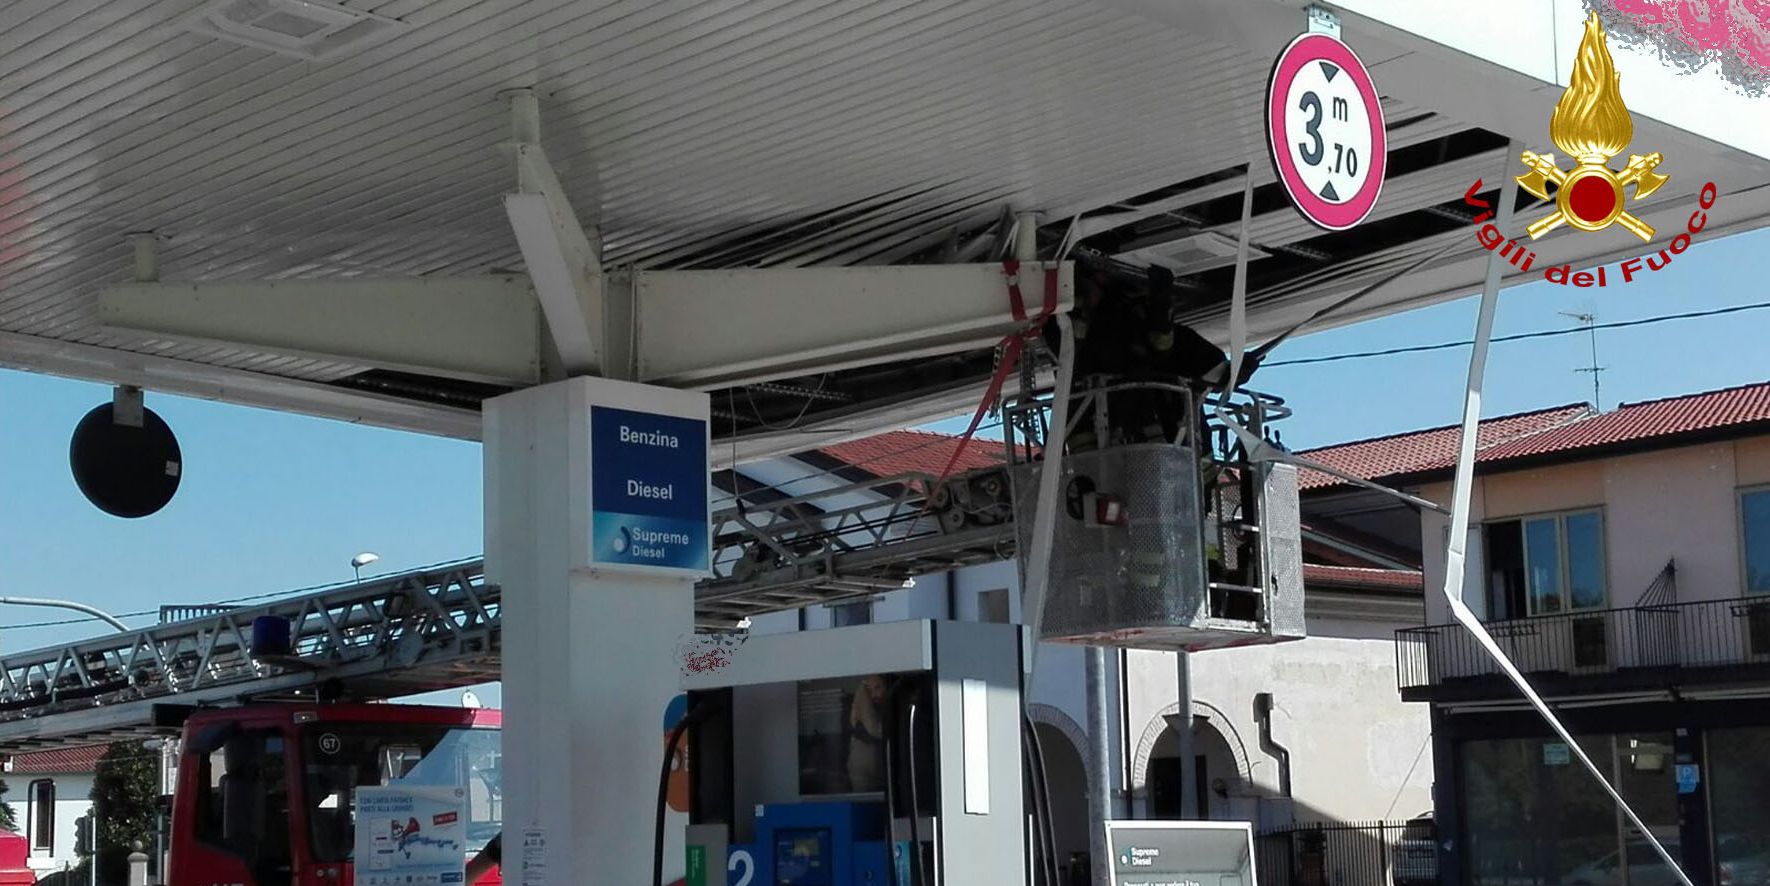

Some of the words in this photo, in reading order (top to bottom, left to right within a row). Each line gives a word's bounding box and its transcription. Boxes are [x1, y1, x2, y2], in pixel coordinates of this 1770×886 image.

[1299, 91, 1324, 166] 3
[1333, 96, 1348, 122] m
[620, 426, 678, 448] Benzina
[627, 480, 673, 500] Diesel
[632, 528, 689, 545] Supreme
[632, 547, 665, 559] Diesel
[323, 738, 335, 749] 67
[1131, 847, 1159, 857] Supreme
[728, 850, 754, 886] 2
[1132, 857, 1152, 866] Diesel
